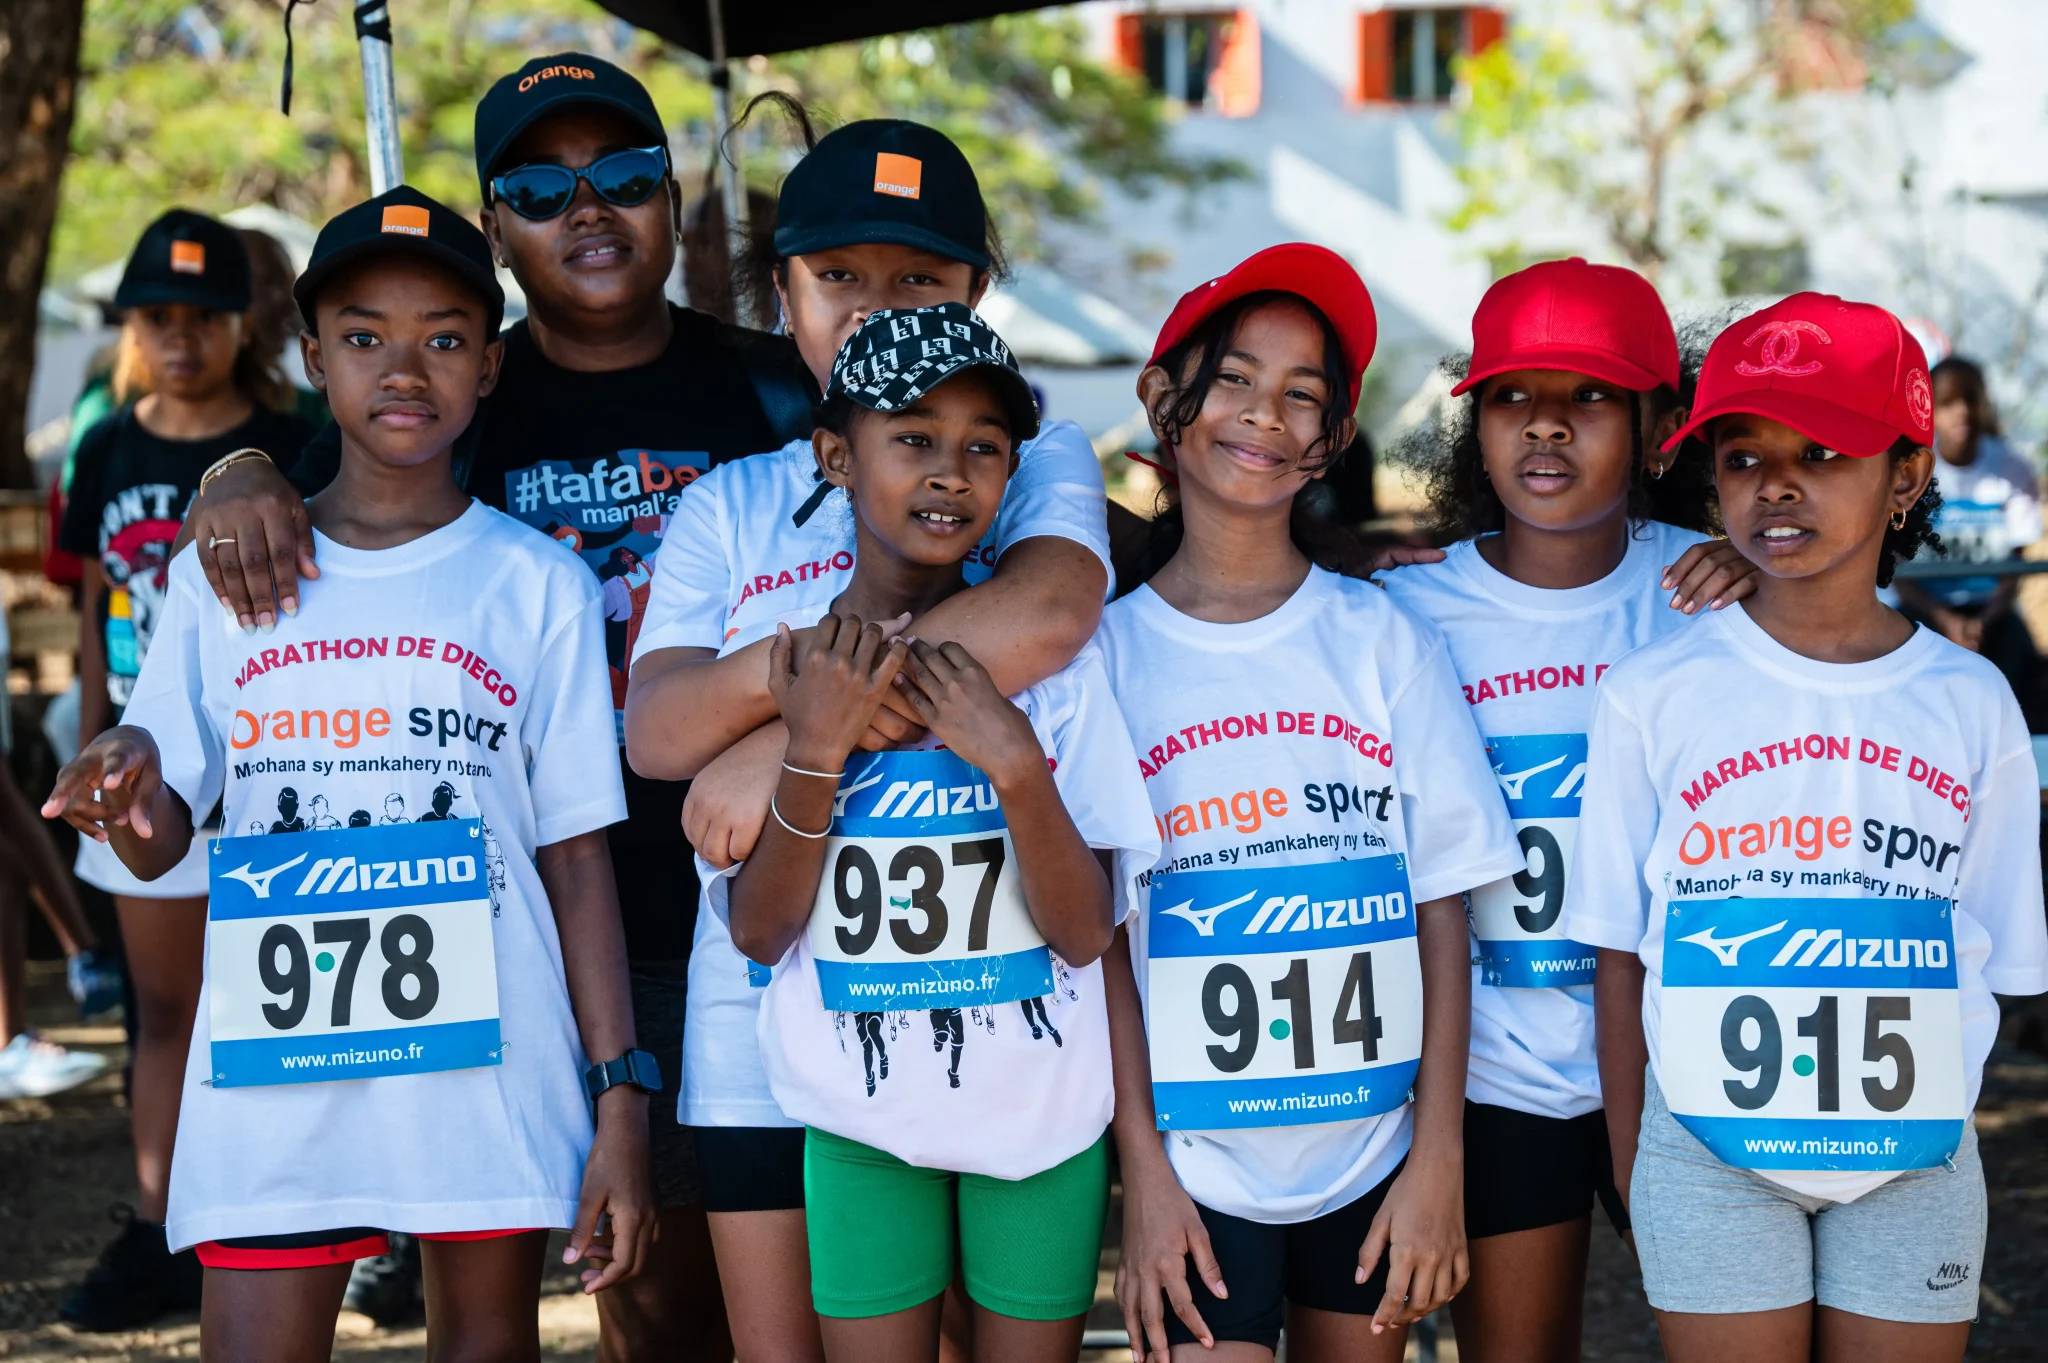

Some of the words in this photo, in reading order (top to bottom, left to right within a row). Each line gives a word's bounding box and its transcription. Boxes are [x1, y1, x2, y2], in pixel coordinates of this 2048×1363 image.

[396, 636, 436, 660] DE
[441, 642, 517, 707] DIEGO
[230, 707, 391, 750] Orange
[408, 706, 507, 752] sport
[1138, 711, 1268, 783] ARATHON
[1276, 711, 1315, 735] DE
[1322, 713, 1393, 767] DIEGO
[312, 759, 334, 776] sy
[339, 756, 441, 776] mankahery
[1680, 733, 1849, 812] MARATHON
[1858, 738, 1902, 772] DE
[1219, 846, 1240, 865] sy
[1246, 832, 1339, 857] mankahery
[1344, 833, 1358, 851] ny
[1678, 815, 1852, 866] Orange
[294, 854, 476, 896] MIZUNO
[834, 836, 1005, 956] 937
[1771, 869, 1794, 888] sy
[1242, 891, 1406, 935] MIZUNO
[1769, 929, 1948, 968] MIZUNO
[258, 913, 439, 1030] 978
[848, 974, 996, 997] www.mizuno.fr
[1201, 951, 1383, 1073] 914
[281, 1042, 424, 1069] www.mizuno.fr
[1720, 994, 1916, 1112] 915
[1228, 1086, 1371, 1113] www.mizuno.fr
[1744, 1137, 1898, 1156] www.mizuno.fr
